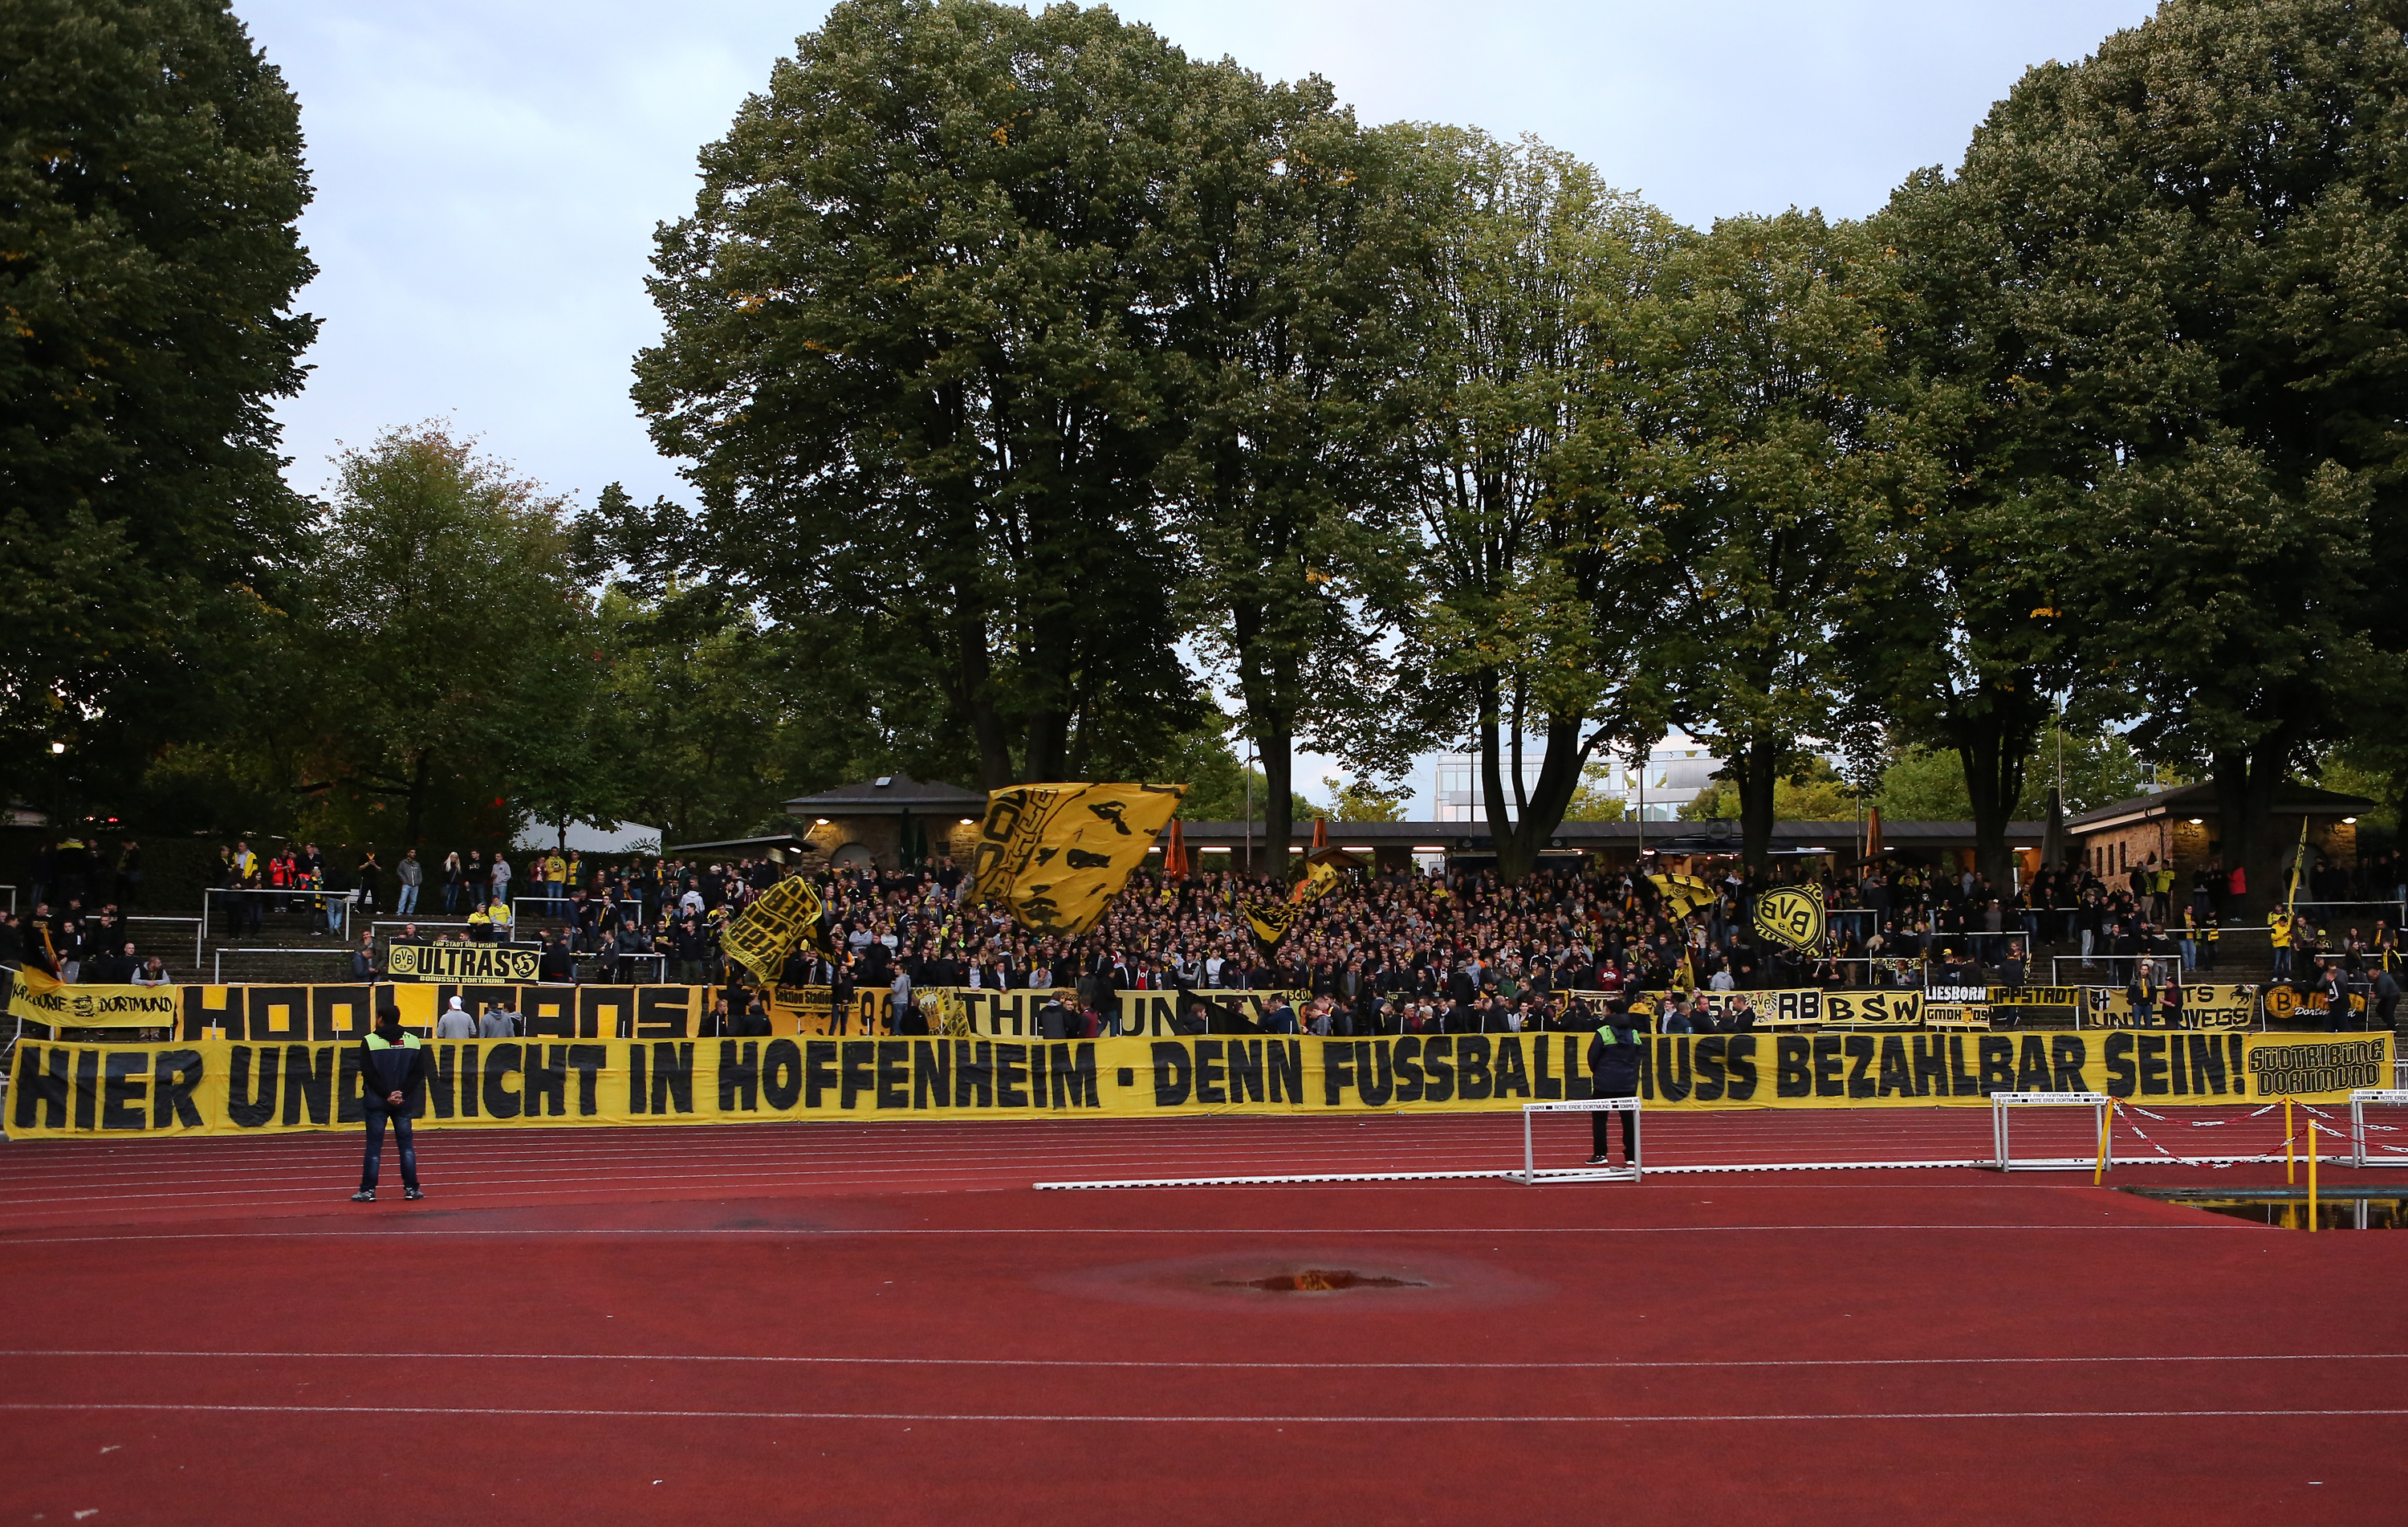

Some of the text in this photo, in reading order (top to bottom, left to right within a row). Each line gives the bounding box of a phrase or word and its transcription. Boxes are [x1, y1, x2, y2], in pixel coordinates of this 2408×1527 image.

[395, 950, 413, 965] BVB
[417, 947, 511, 977] ULTRAS
[419, 975, 506, 984] BORUSSIA DORTMUND
[1925, 986, 1987, 1001] LIESBORN
[100, 996, 173, 1012] DORTMUND
[775, 987, 804, 1004] Sektion
[1778, 991, 1820, 1020] RB
[1827, 991, 1921, 1023] BSW
[2248, 1038, 2386, 1073] SÜDTRIBÜNE
[14, 1045, 204, 1130] HIER
[411, 1043, 606, 1119] NICHT
[628, 1041, 694, 1114] IN
[718, 1039, 1101, 1111] HOFFENHEIM
[1150, 1039, 1304, 1108] DENN
[1323, 1035, 1592, 1106] FUSSBALL
[1776, 1033, 2087, 1099] BEZAHLBAR
[2104, 1032, 2246, 1098] SEIN!
[2258, 1061, 2380, 1096] DORTMUND
